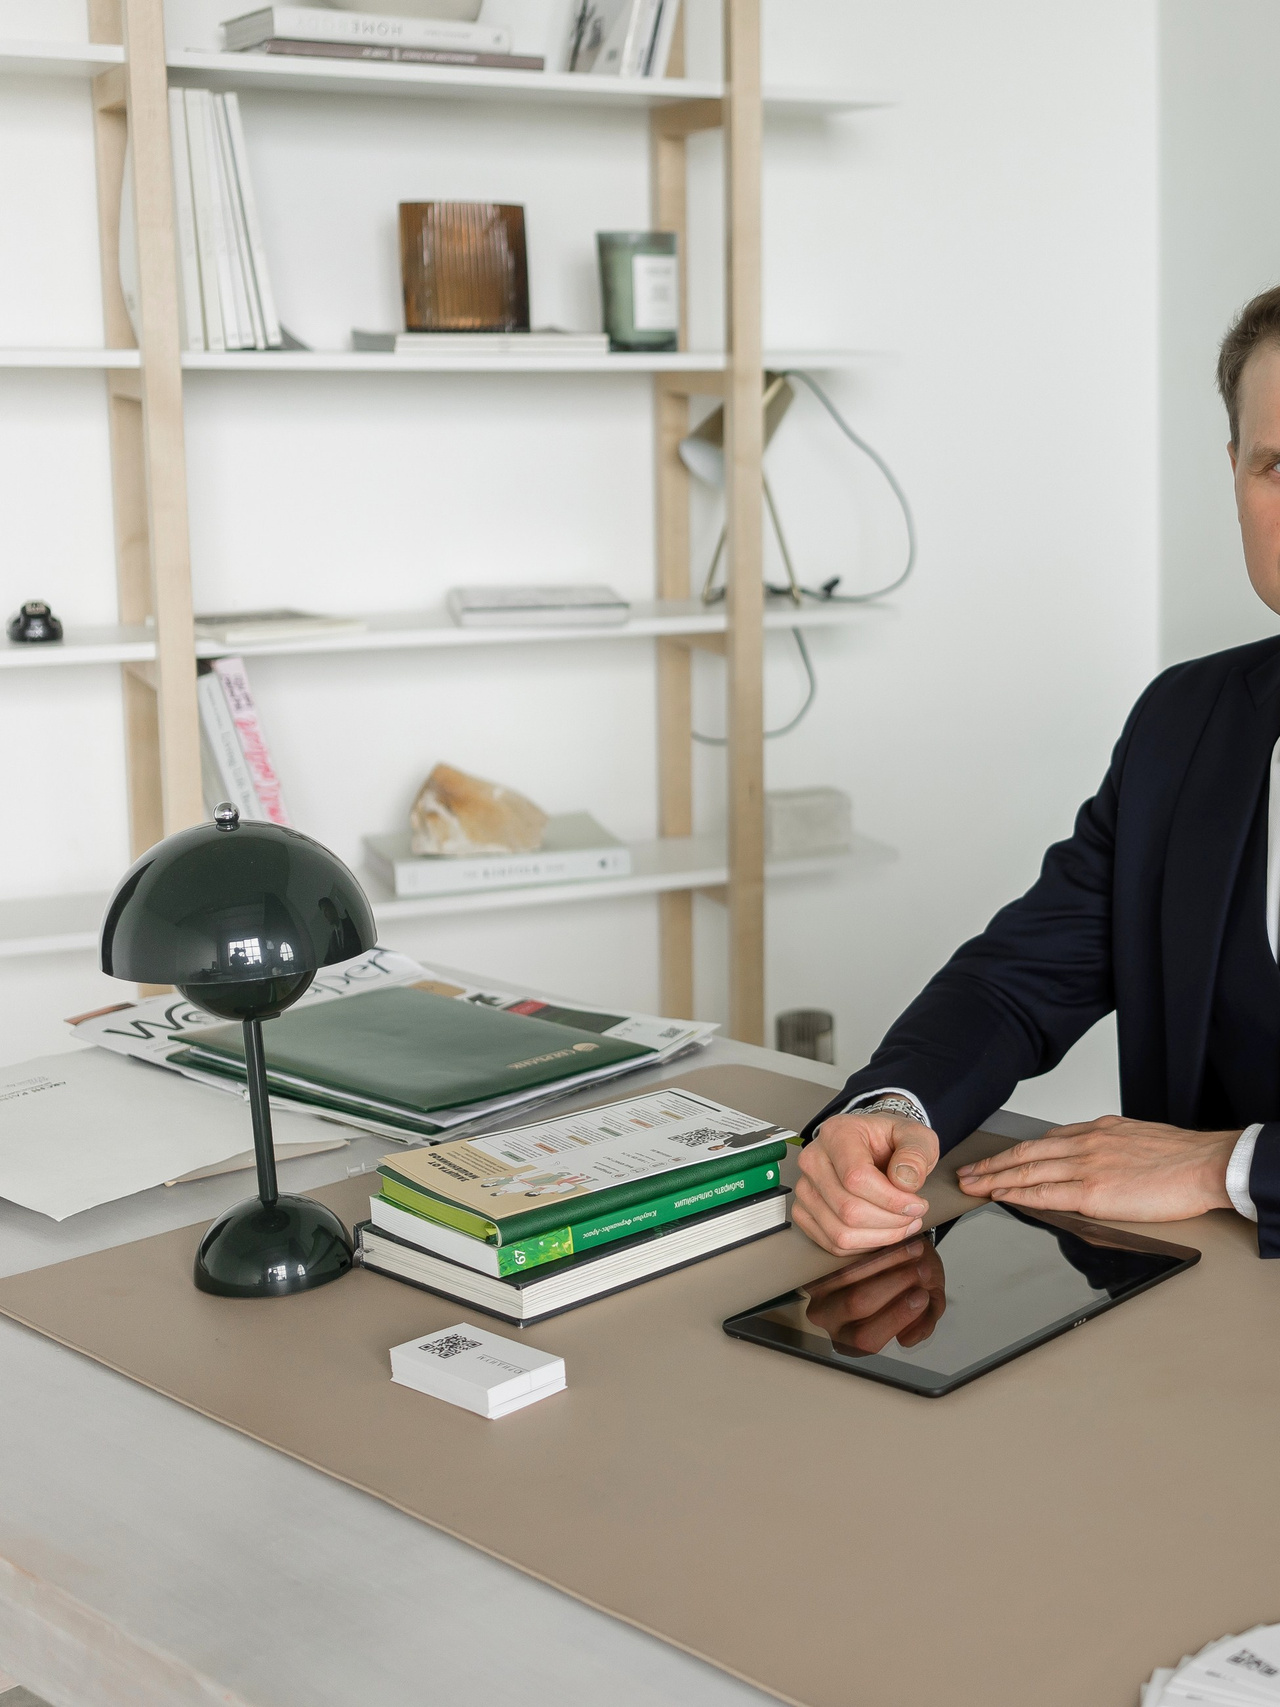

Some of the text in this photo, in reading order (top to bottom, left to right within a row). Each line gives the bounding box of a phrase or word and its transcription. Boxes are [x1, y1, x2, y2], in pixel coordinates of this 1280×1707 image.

[673, 1179, 745, 1210] Выбирать сильнейших
[582, 1209, 658, 1240] Клаудио Фернандес-Араос
[514, 1250, 527, 1265] 67
